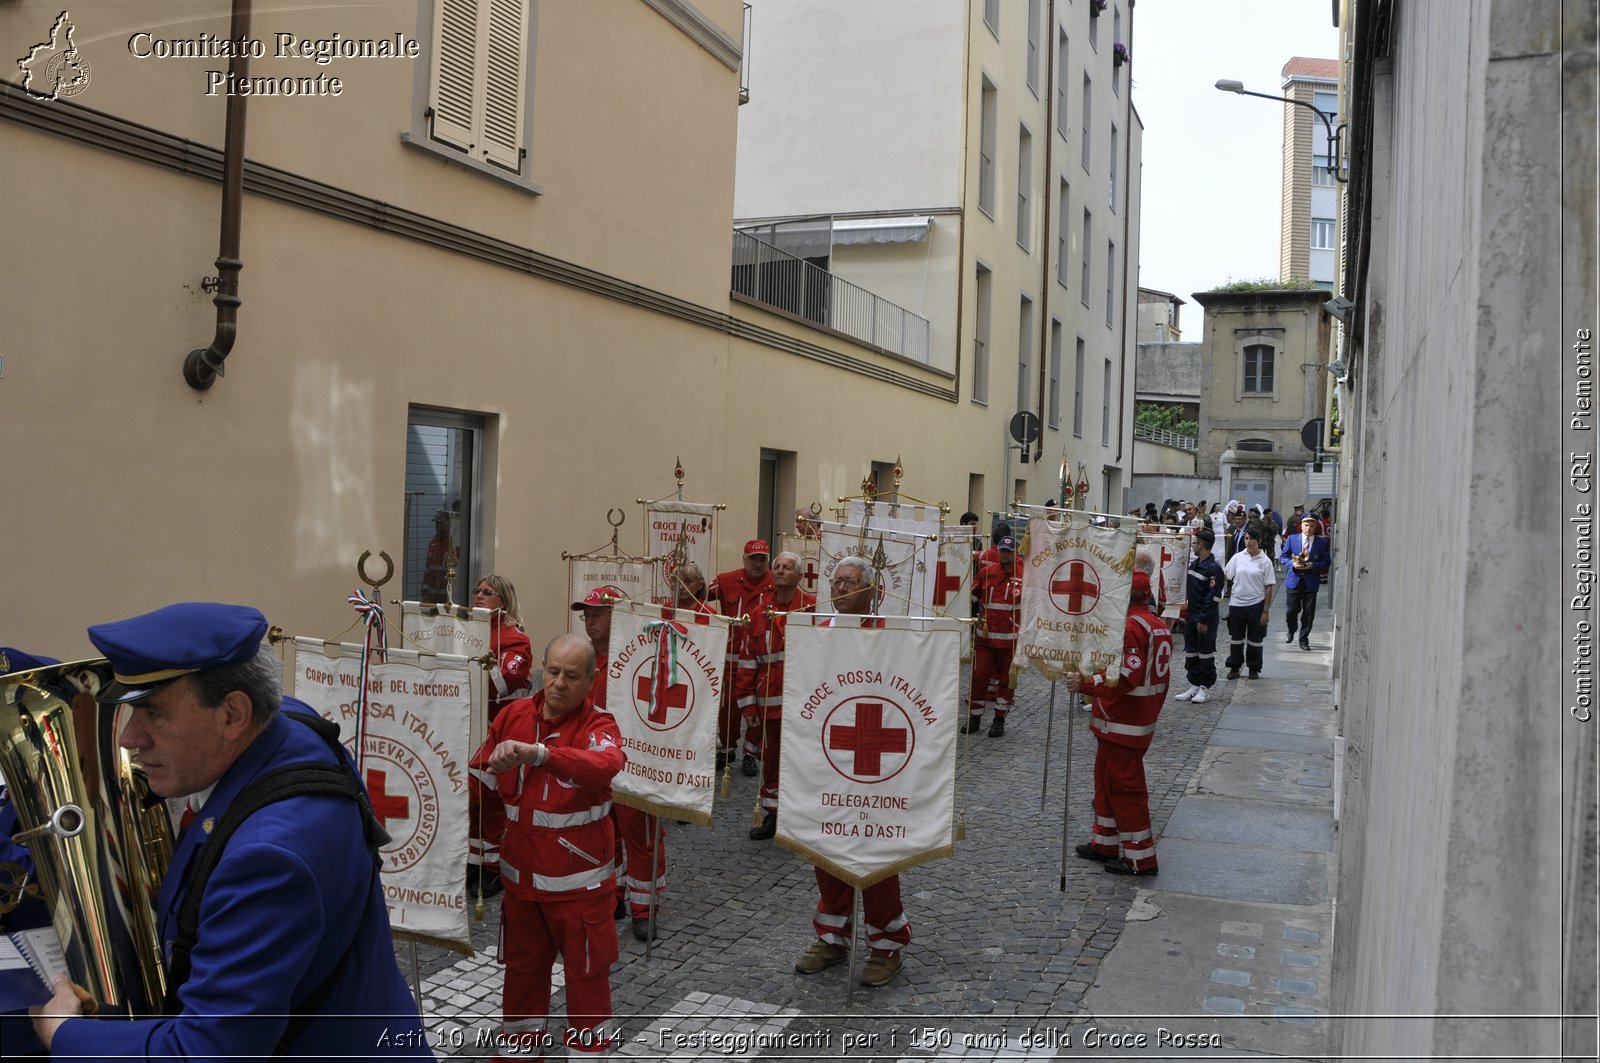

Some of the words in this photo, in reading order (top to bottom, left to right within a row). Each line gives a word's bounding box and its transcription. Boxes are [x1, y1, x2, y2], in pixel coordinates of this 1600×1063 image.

[653, 521, 677, 530] CROCE
[1056, 537, 1087, 552] ROSSA
[1089, 544, 1126, 577] ITALIANA
[1036, 618, 1109, 636] DELEGAZIONE
[1070, 634, 1078, 642] DI
[1024, 645, 1082, 662] COCCONATO
[610, 640, 637, 679] CROCE
[680, 637, 720, 697] ITALIANA
[305, 667, 334, 686] CORPO
[390, 680, 409, 694] DEL
[413, 683, 460, 698] SOCCORSO
[800, 681, 833, 720] CROCE
[837, 670, 883, 687] ROSSA
[890, 675, 938, 727] ITALIANA
[401, 710, 464, 793] ITALIANA
[622, 737, 682, 760] DELEGAZIONE
[686, 750, 697, 761] DI
[414, 771, 430, 790] 22
[677, 773, 711, 788] D'ASTI
[821, 793, 909, 810] DELEGAZIONE
[415, 793, 435, 847] AGOSTO
[859, 811, 869, 821] DI
[821, 822, 860, 837] ISOLA
[864, 823, 906, 839] D'ASTI
[390, 844, 420, 868] 1864
